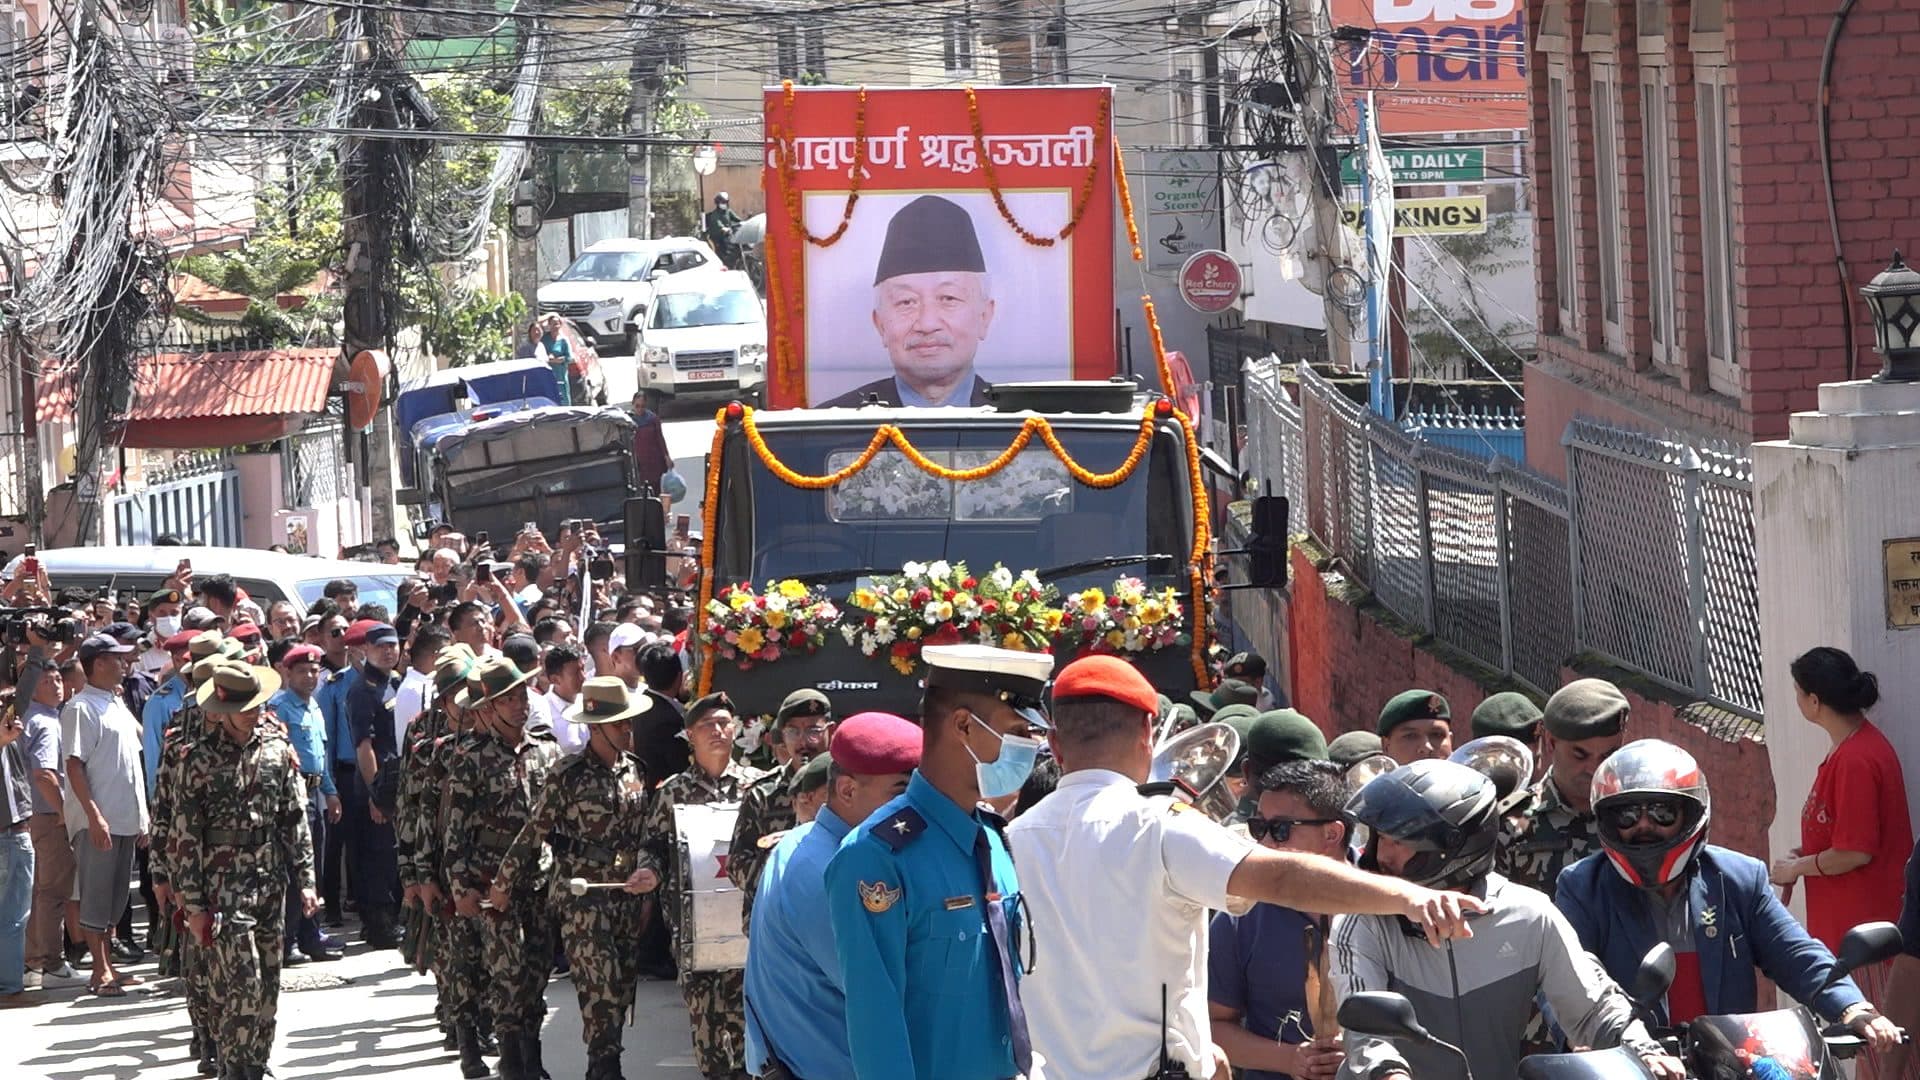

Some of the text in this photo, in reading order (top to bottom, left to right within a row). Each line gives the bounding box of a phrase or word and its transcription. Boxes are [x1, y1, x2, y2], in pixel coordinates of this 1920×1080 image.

[1411, 152, 1468, 169] DAILY
[1402, 171, 1418, 180] TO
[1420, 170, 1445, 180] 9PM
[1154, 191, 1207, 210] Organic Store
[1340, 206, 1461, 230] PAKING
[1185, 279, 1237, 290] Red Cherry
